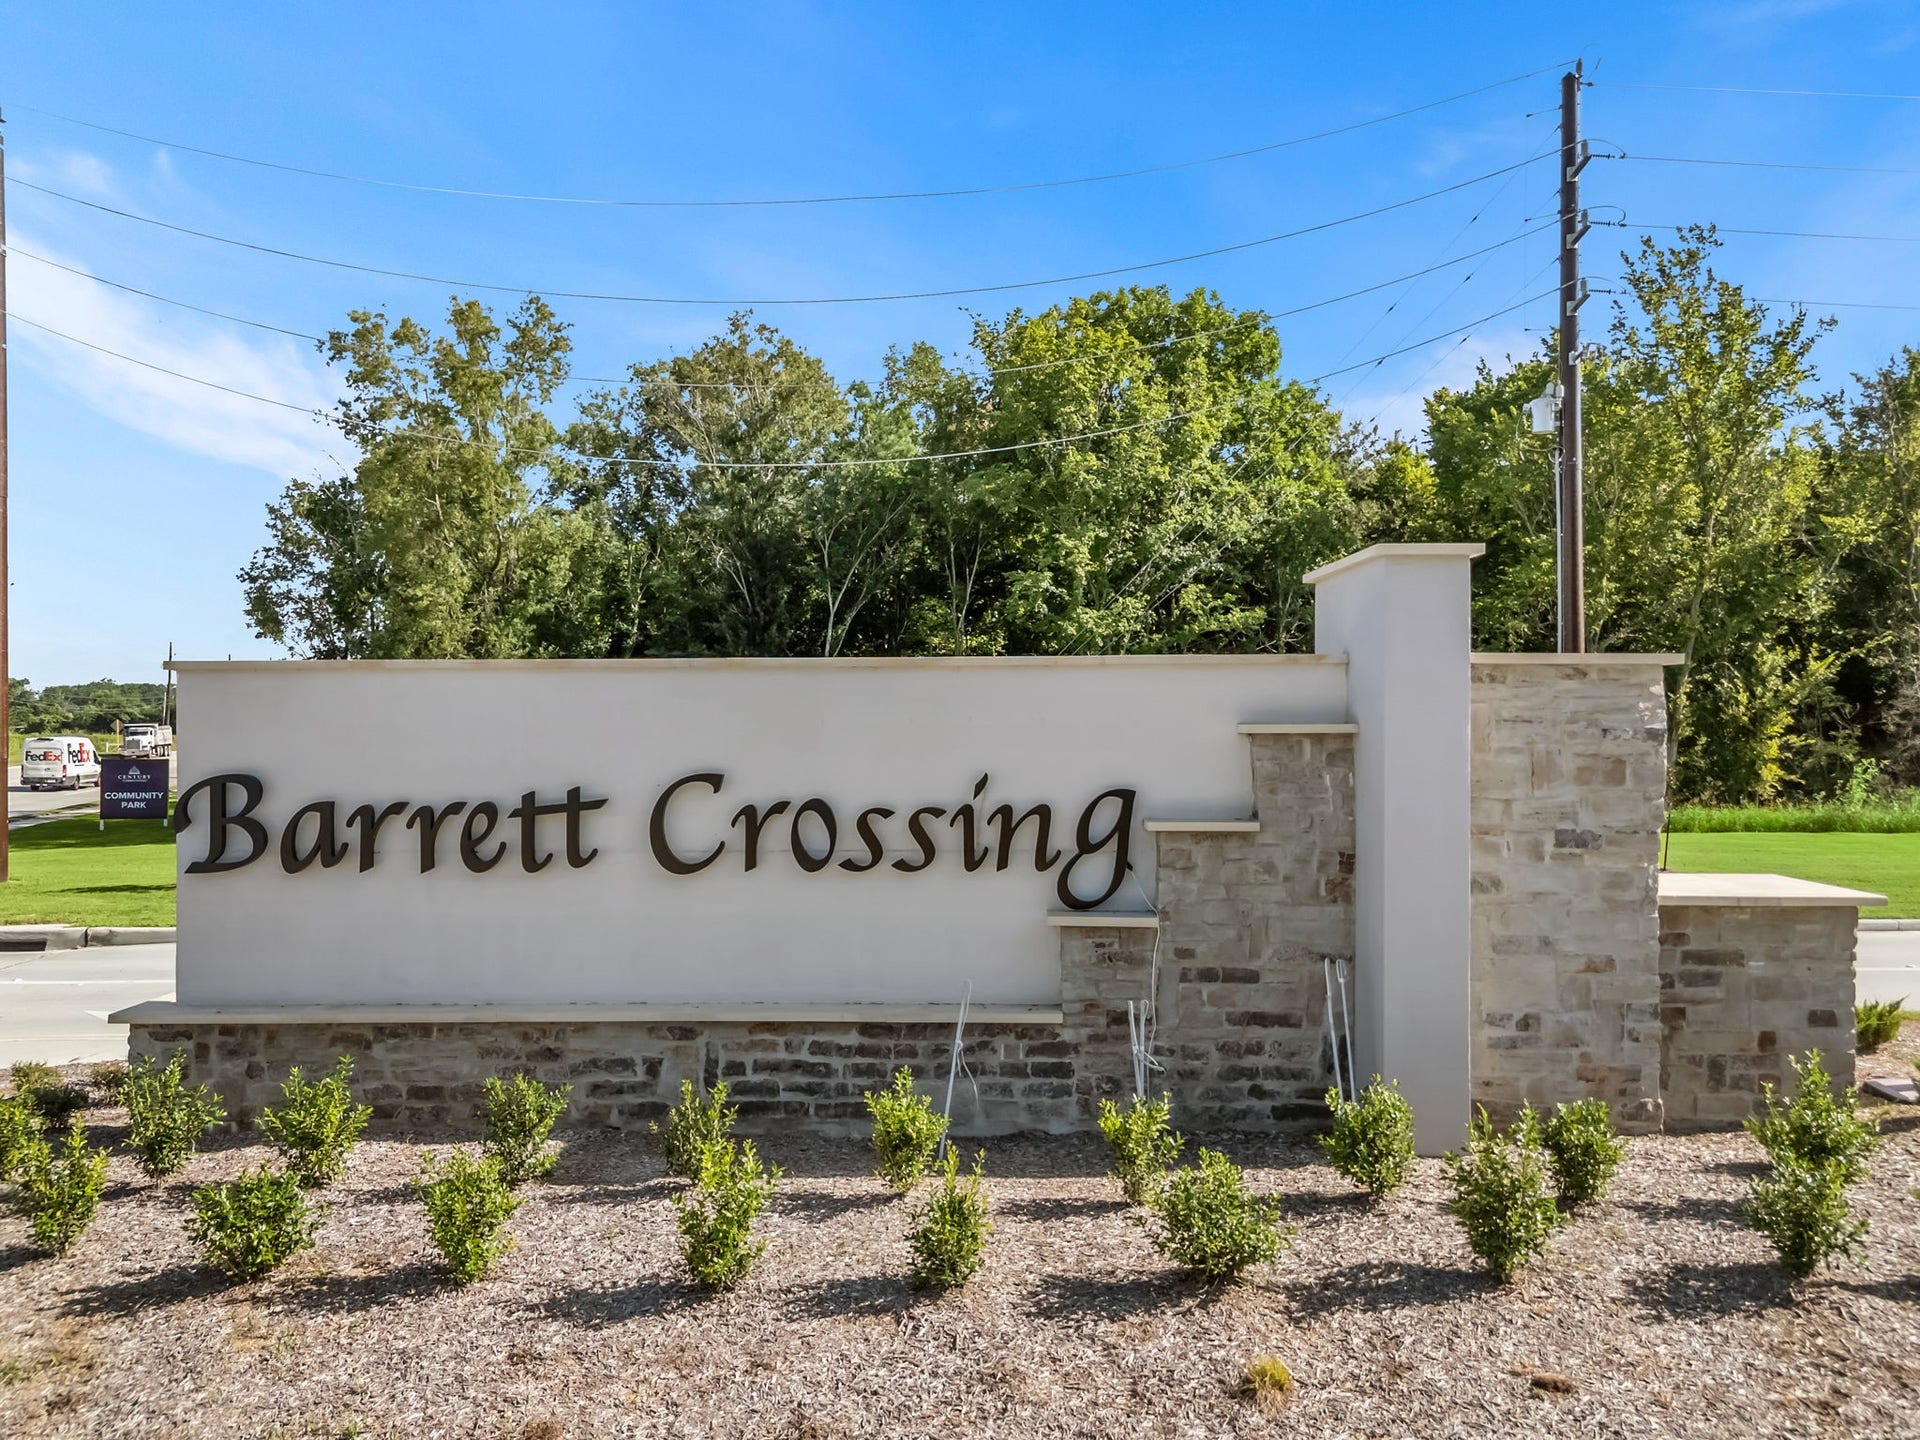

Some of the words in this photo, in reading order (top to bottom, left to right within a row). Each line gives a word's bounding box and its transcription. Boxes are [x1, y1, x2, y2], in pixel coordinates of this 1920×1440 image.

[25, 750, 61, 762] FedEx
[67, 743, 91, 764] FedEx
[104, 791, 164, 800] COMMUNITY
[121, 801, 147, 809] PARK
[174, 773, 609, 874] Barrett
[649, 772, 1137, 910] Crossing
